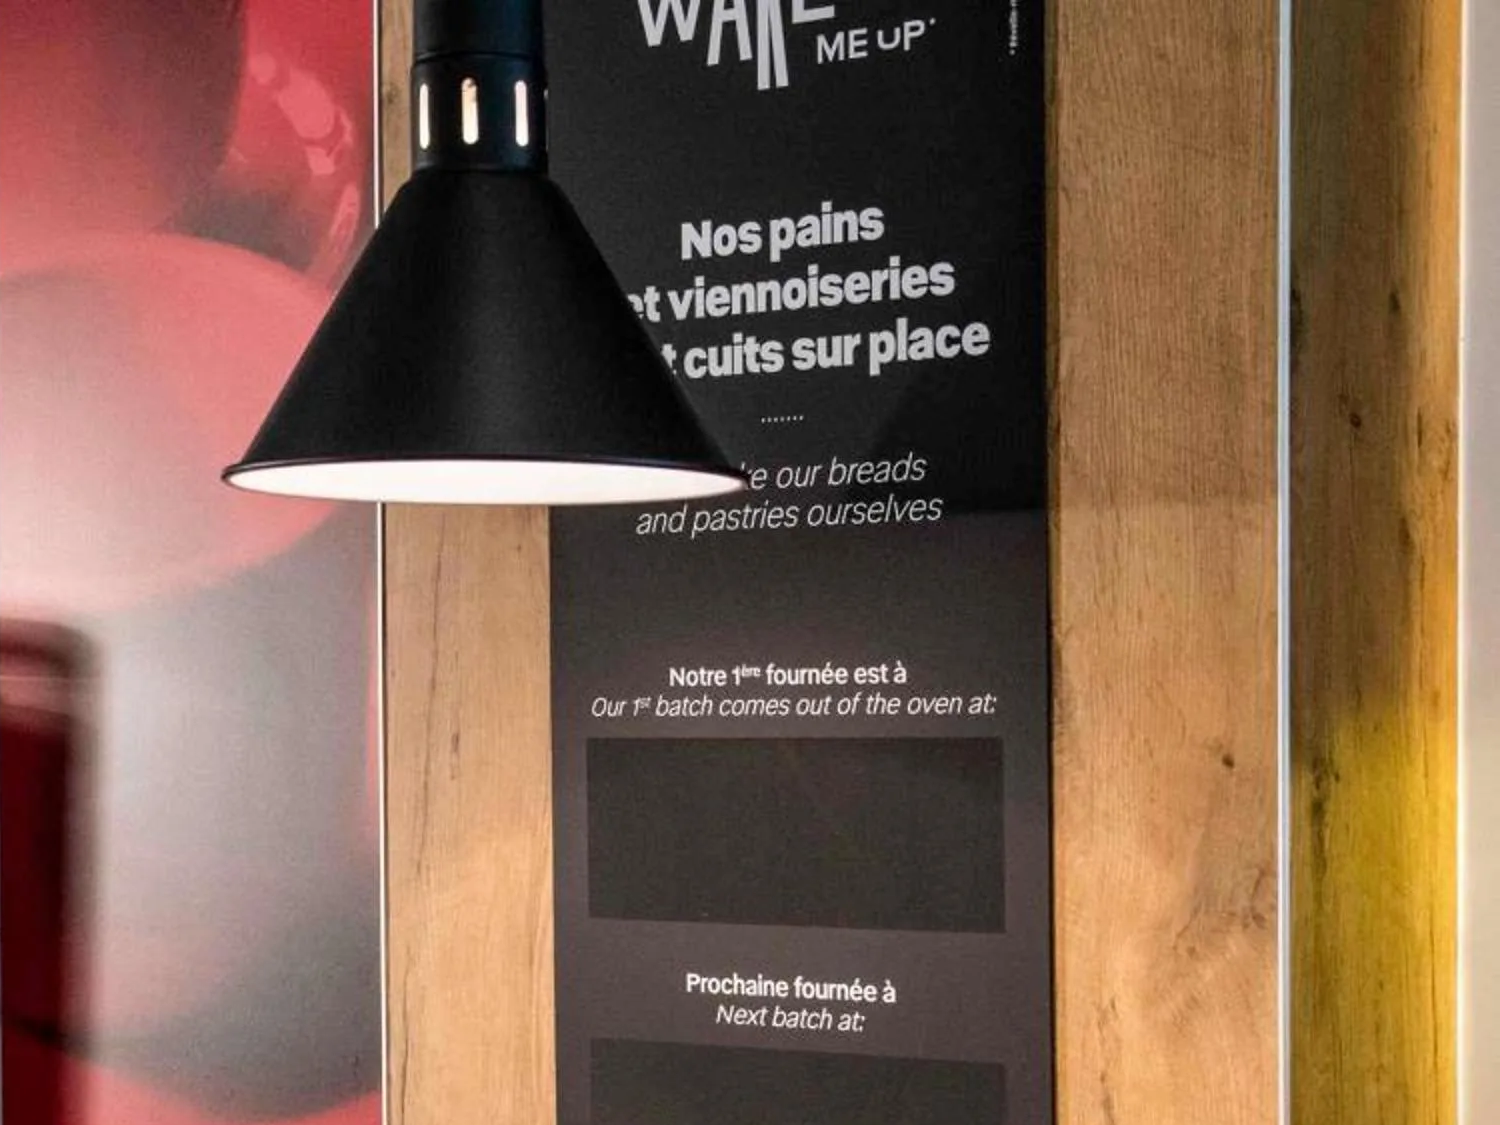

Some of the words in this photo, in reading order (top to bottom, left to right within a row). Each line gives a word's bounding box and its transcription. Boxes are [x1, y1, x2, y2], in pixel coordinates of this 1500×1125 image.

[816, 28, 868, 64] ME
[681, 220, 762, 260] Nos
[769, 201, 885, 263] pains
[667, 255, 955, 322] viennoiseries
[683, 333, 784, 379] cuits
[792, 334, 861, 371] sur
[869, 317, 991, 377] place
[776, 464, 823, 489] our
[828, 451, 928, 487] breads
[636, 503, 688, 535] and
[691, 499, 800, 540] pastries
[807, 493, 943, 527] ourselves
[669, 666, 728, 688] Notre
[766, 662, 849, 687] fournée
[854, 663, 890, 685] est
[893, 659, 908, 685] à
[591, 697, 628, 718] Our
[655, 694, 714, 717] batch
[719, 699, 791, 717] comes
[796, 695, 833, 716] out
[837, 691, 863, 716] of
[866, 691, 901, 716] the
[907, 696, 962, 716] oven
[967, 692, 998, 716] at:
[685, 971, 790, 998] Prochaine
[793, 975, 879, 1002] fournée
[881, 978, 897, 1003] à
[715, 1004, 769, 1027] Next
[771, 1004, 834, 1031] batch
[837, 1010, 867, 1033] at:
